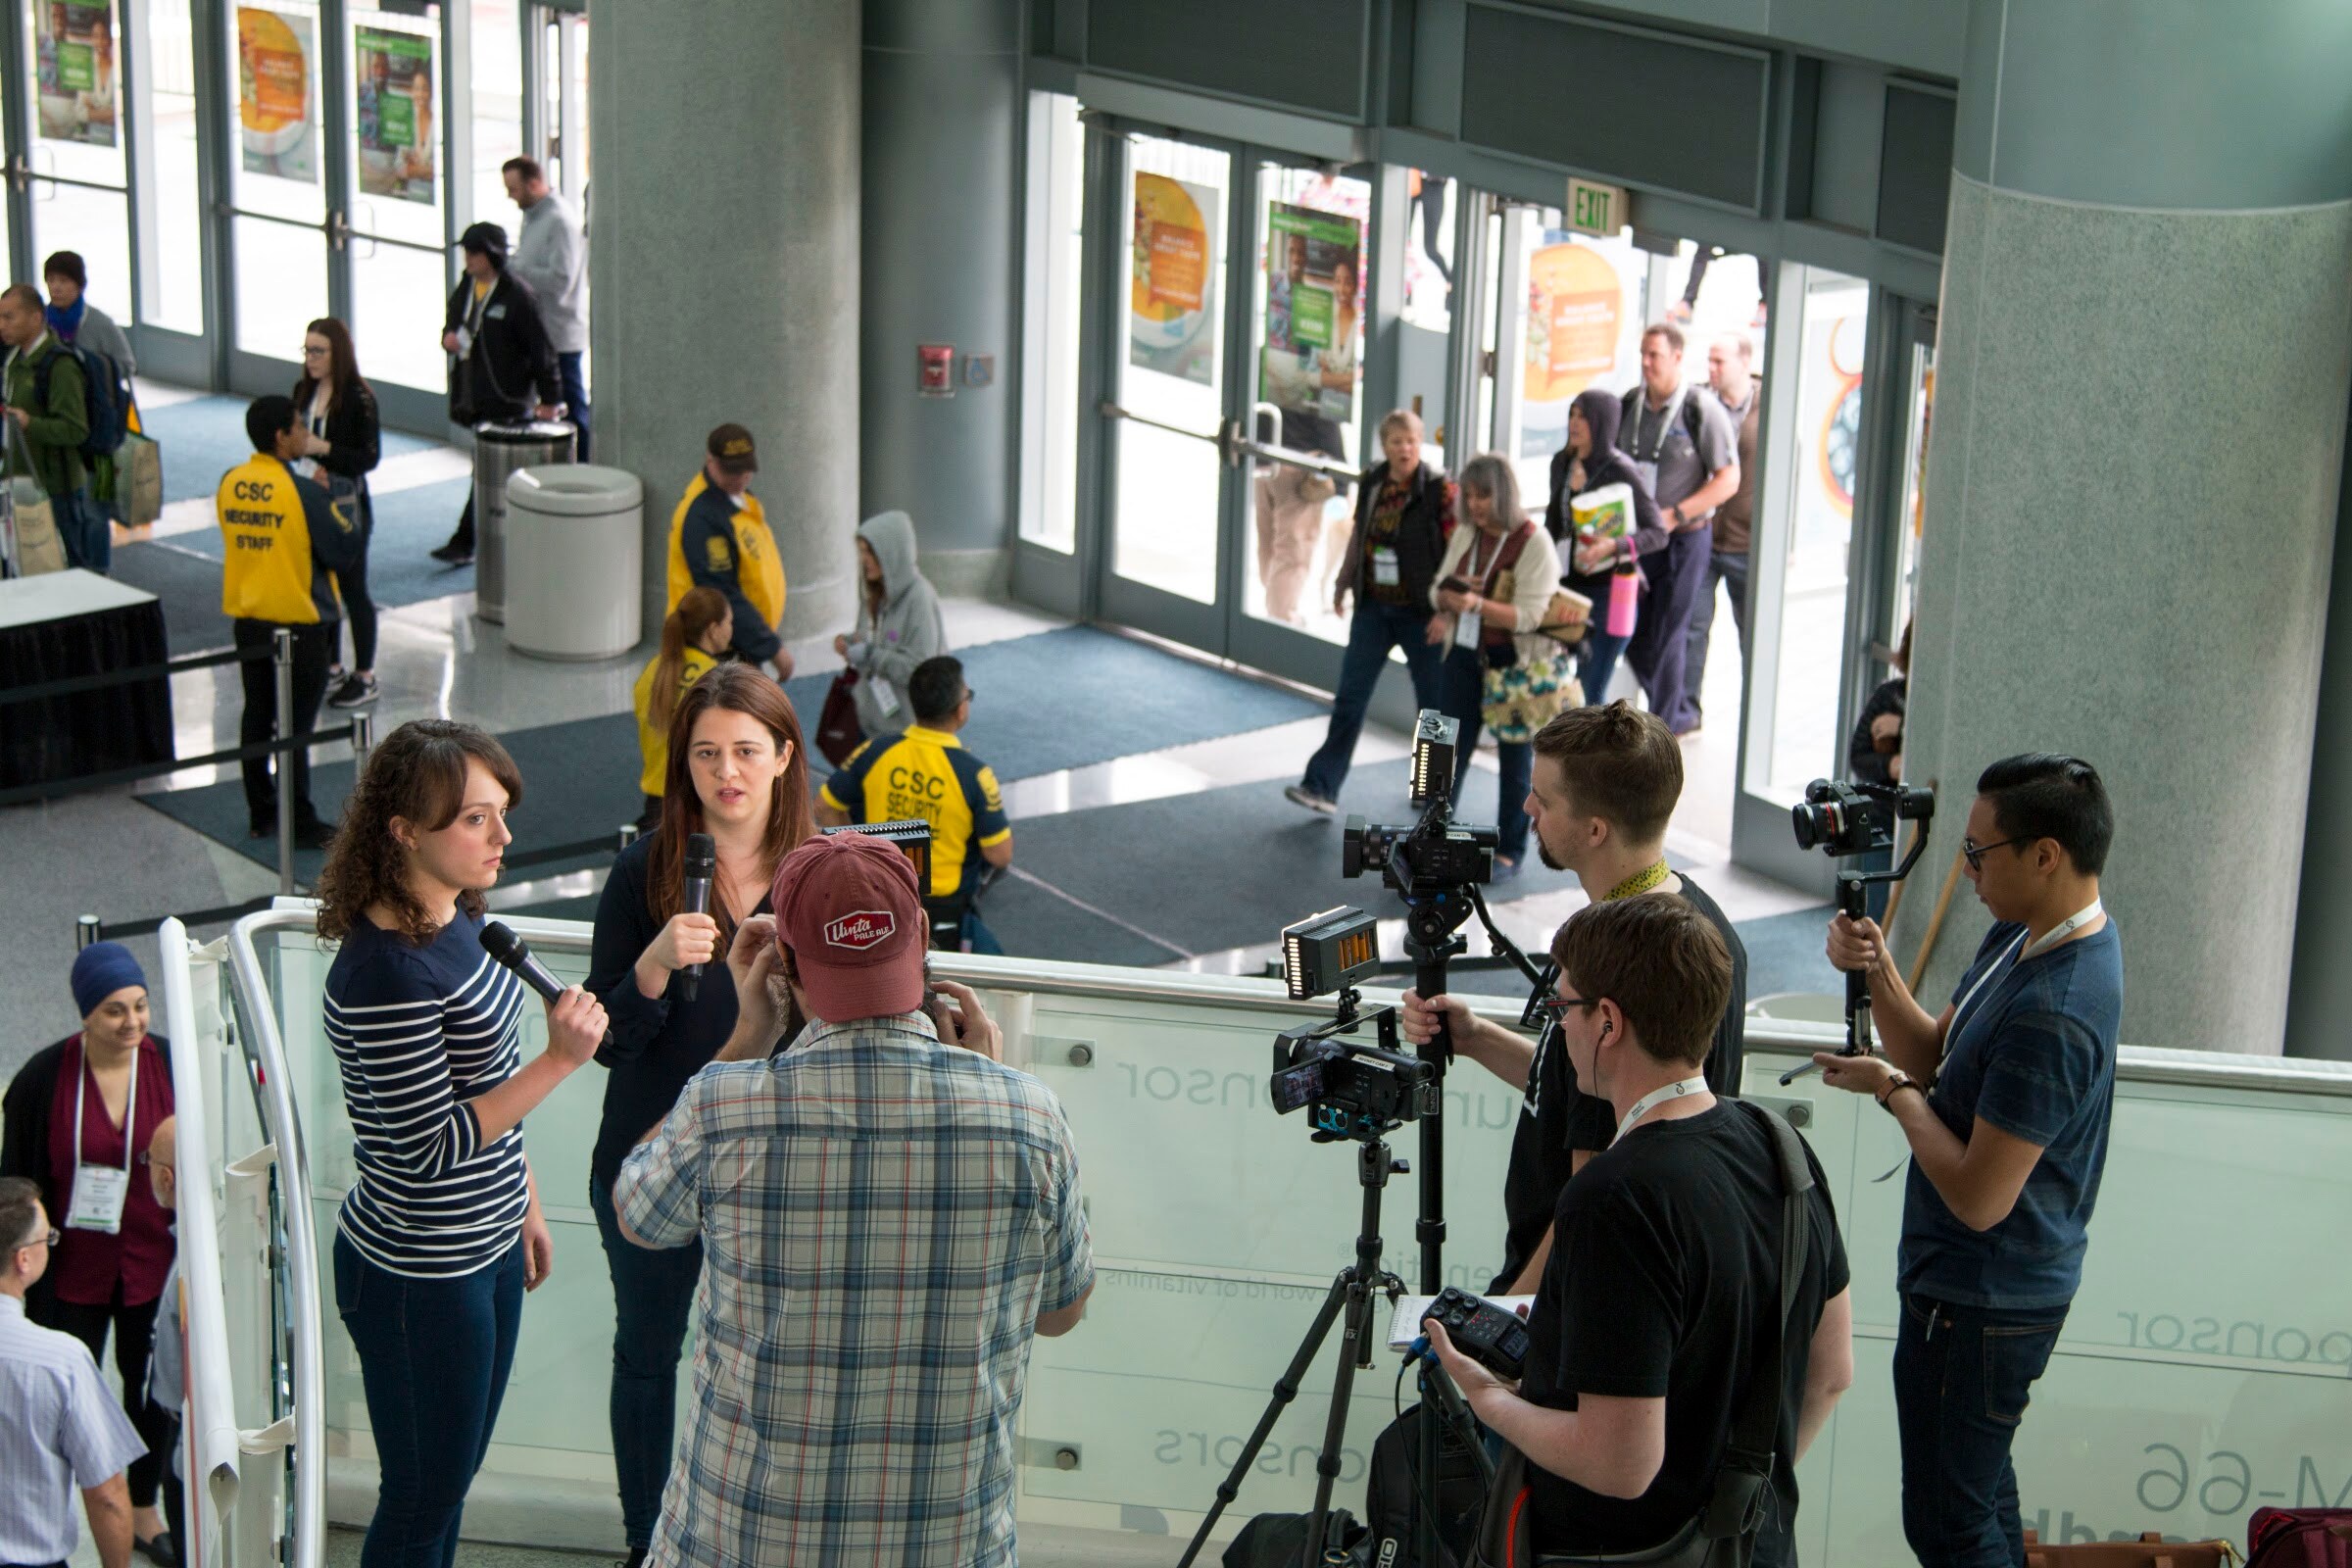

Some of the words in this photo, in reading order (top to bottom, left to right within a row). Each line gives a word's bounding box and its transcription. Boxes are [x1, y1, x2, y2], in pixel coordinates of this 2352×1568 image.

[1575, 186, 1611, 232] EXIT
[234, 480, 273, 503] CSC
[224, 509, 284, 529] SECURITY
[236, 534, 273, 551] STAFF
[889, 766, 946, 801] CSC
[887, 792, 943, 818] SECURITY
[832, 918, 871, 942] Uinta
[854, 930, 875, 941] PALE
[875, 926, 890, 937] ALE
